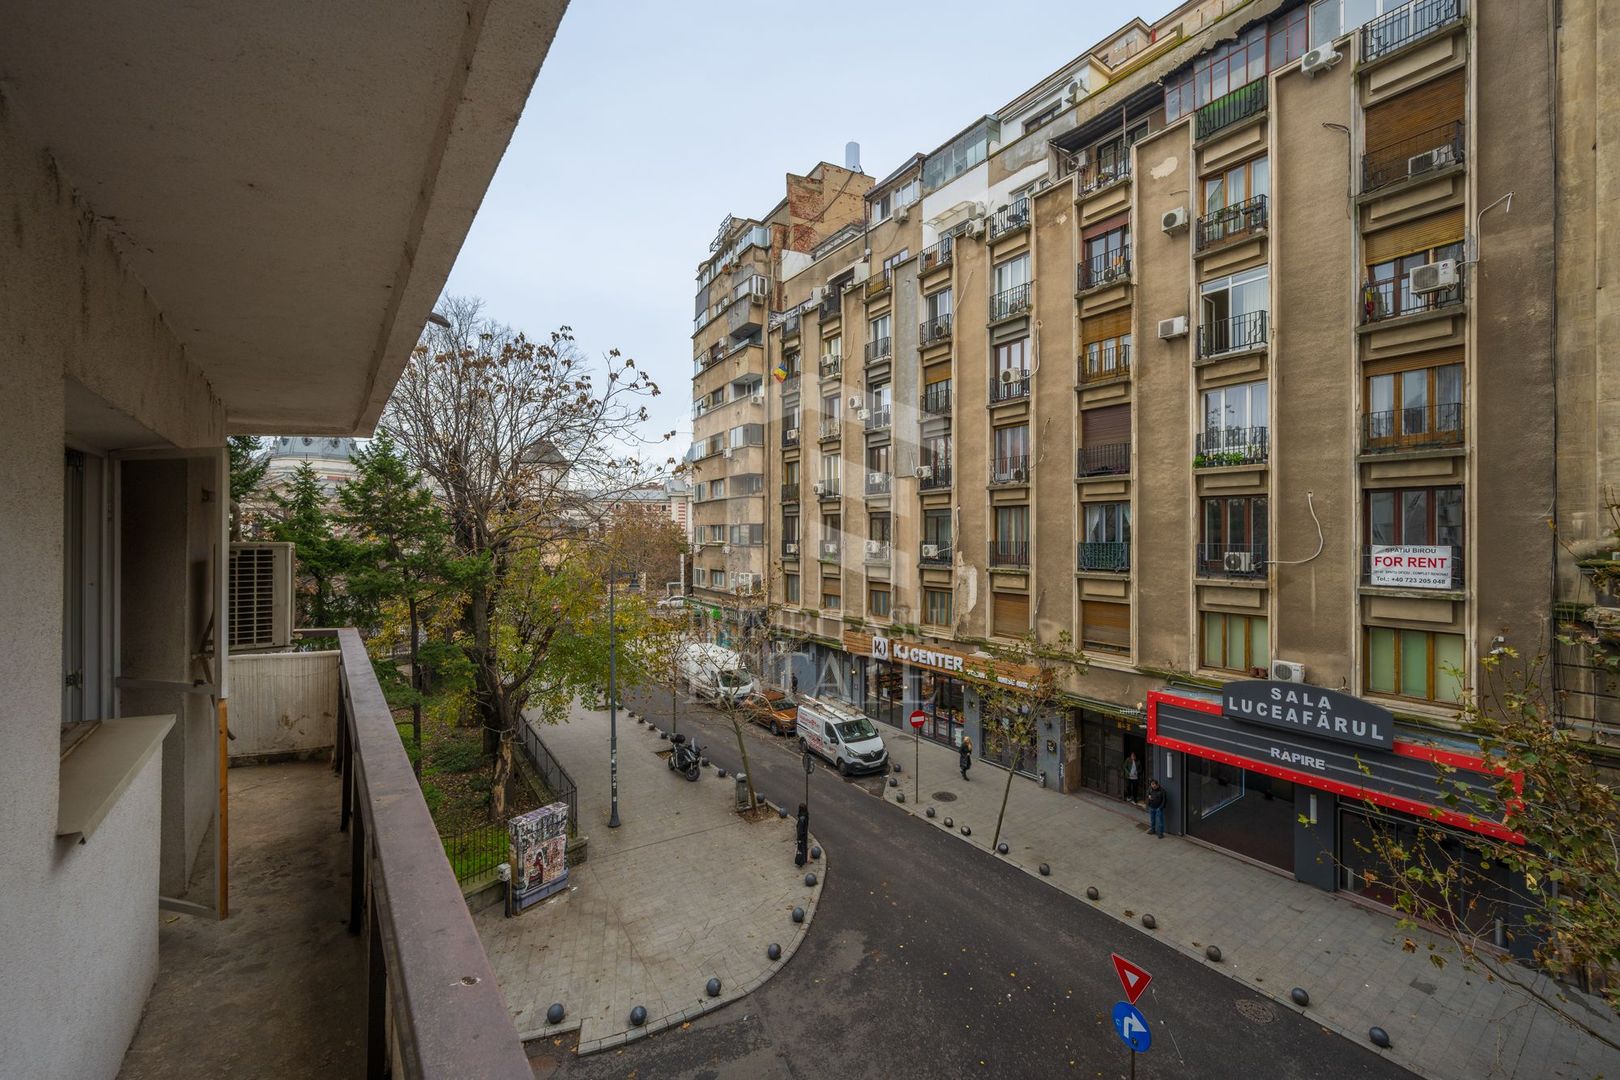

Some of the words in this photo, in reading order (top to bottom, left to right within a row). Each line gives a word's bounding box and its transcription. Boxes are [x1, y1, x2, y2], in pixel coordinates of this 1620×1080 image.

[1374, 556, 1403, 567] FOR
[1408, 557, 1447, 568] RENT
[892, 643, 910, 661] KJ
[910, 648, 964, 673] CENTER
[1270, 686, 1332, 710] SALA
[1228, 695, 1385, 741] LUCEAFĂRUL
